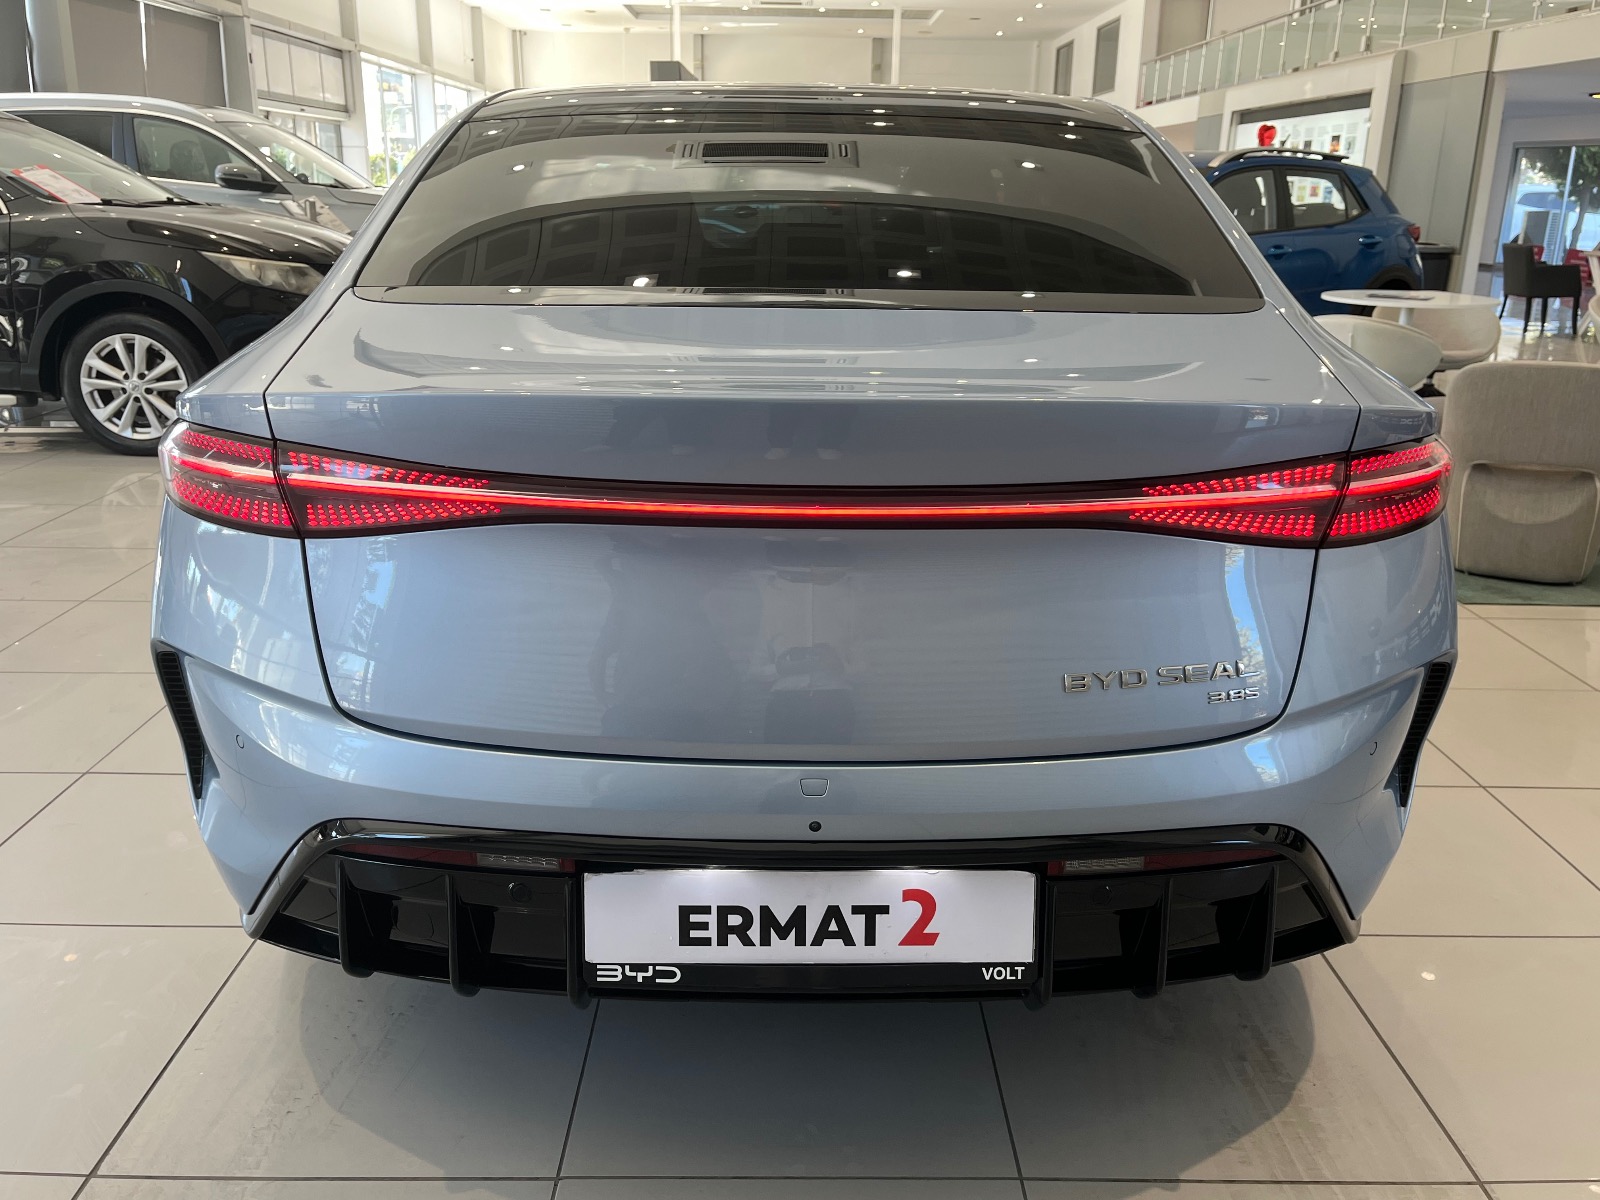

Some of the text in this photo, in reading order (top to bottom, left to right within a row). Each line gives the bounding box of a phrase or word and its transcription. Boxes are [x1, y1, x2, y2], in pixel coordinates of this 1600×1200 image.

[1063, 660, 1261, 693] BYD SEAL
[678, 904, 890, 947] ERMAT
[596, 964, 682, 984] BYD
[981, 966, 1025, 981] VOLT
